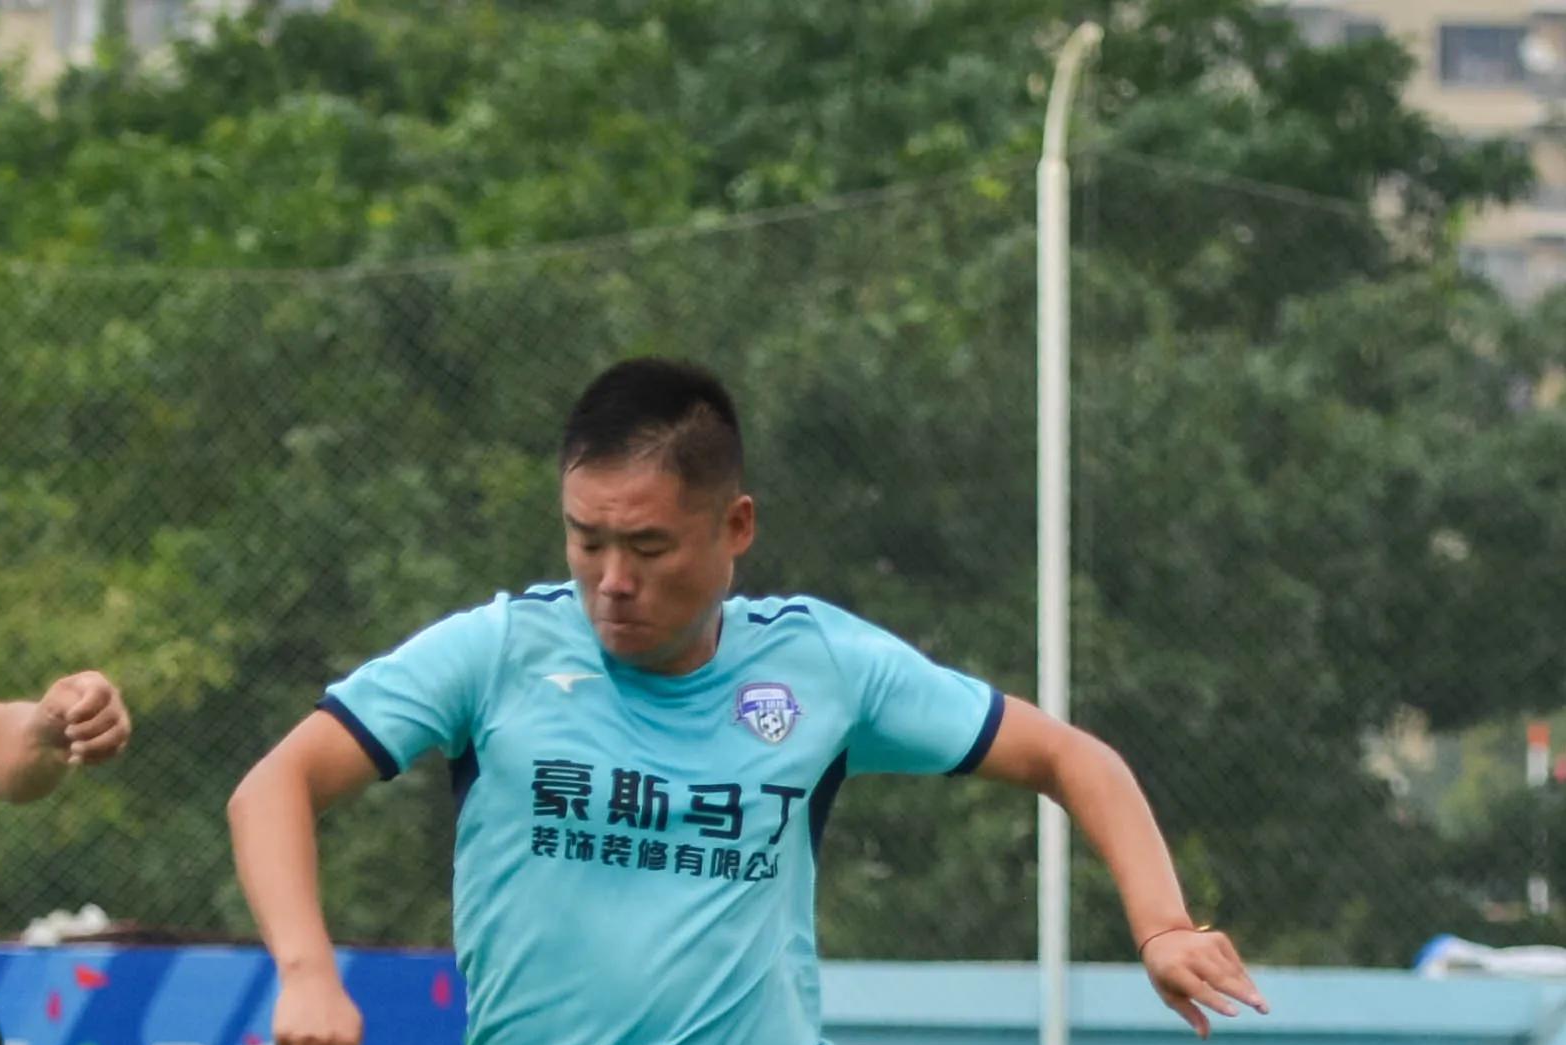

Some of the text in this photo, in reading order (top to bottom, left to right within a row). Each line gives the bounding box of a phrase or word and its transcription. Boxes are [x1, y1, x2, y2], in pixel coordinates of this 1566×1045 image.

[531, 759, 806, 845] 豪斯马丁
[530, 826, 780, 881] 装饰装修有限公
